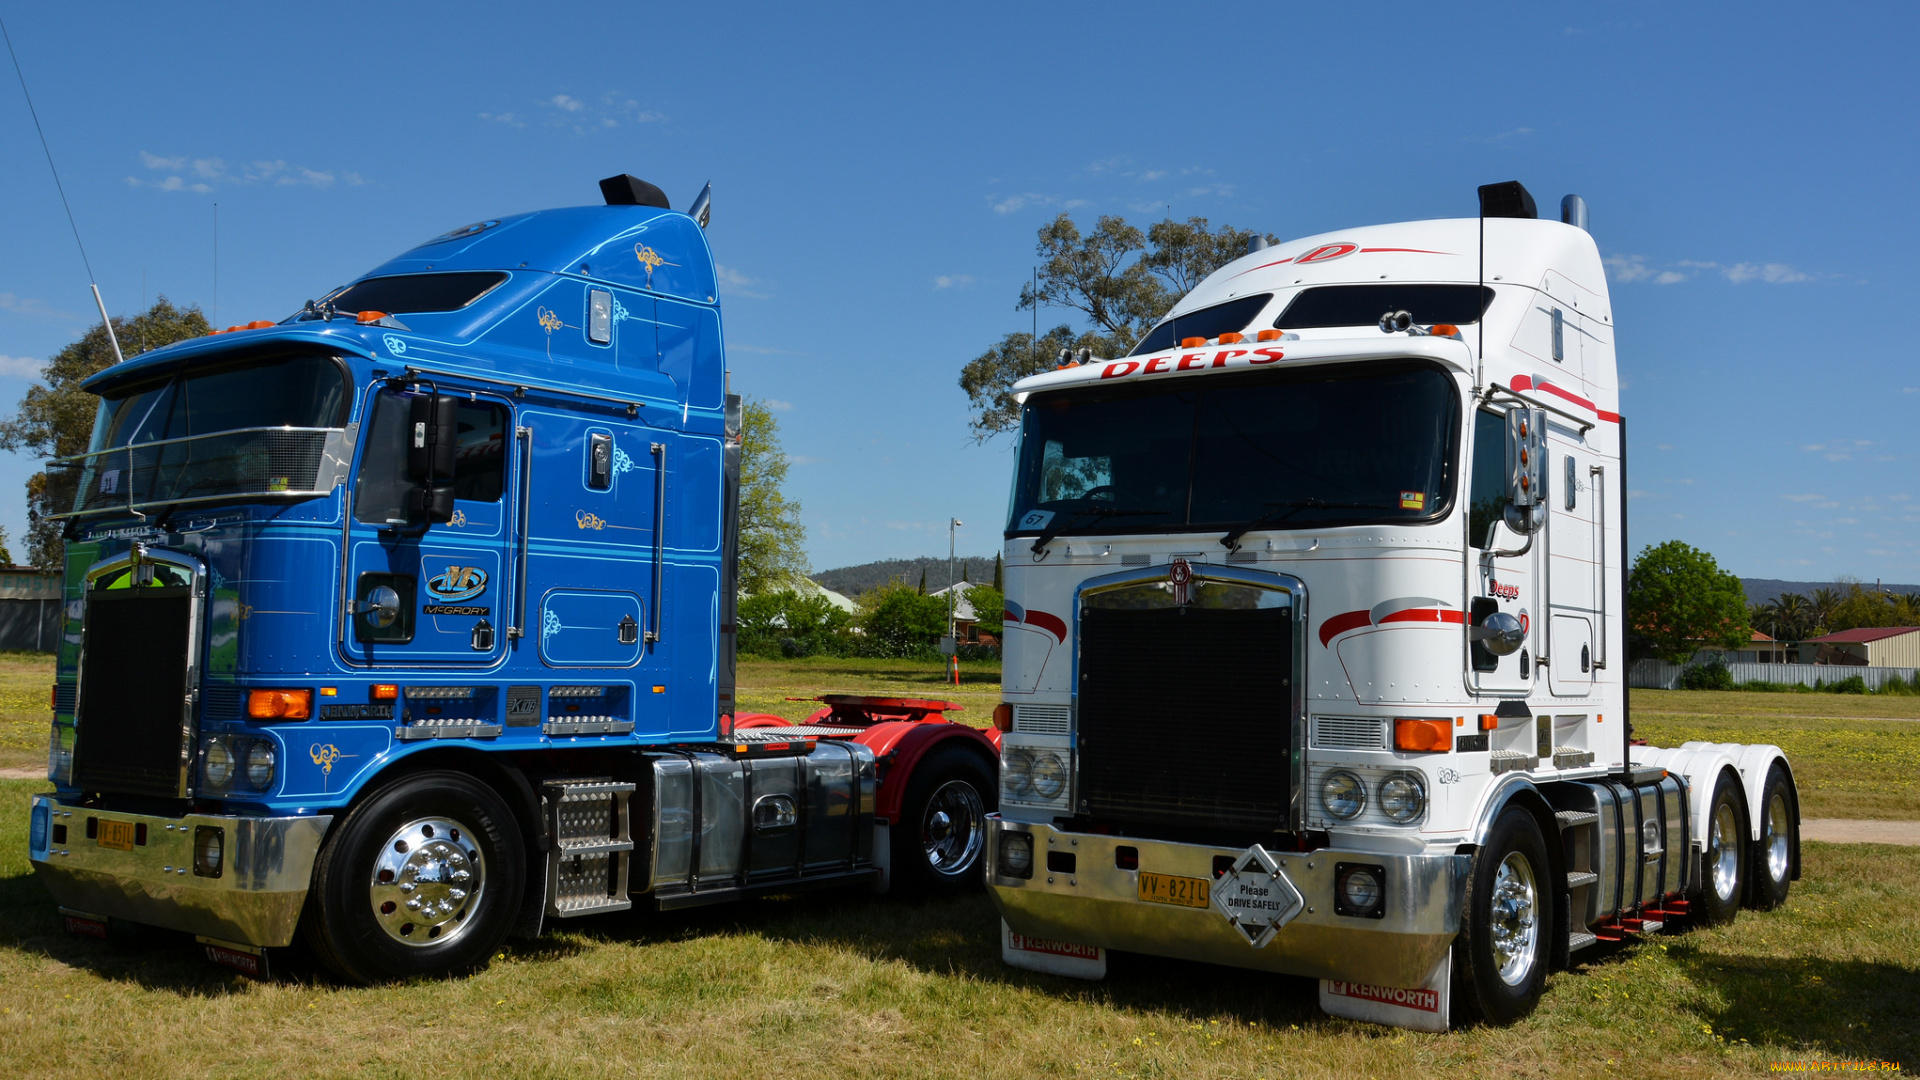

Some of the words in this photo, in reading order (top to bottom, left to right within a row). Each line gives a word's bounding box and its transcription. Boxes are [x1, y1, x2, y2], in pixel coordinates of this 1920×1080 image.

[1100, 346, 1284, 380] DEEPS
[1026, 513, 1044, 526] 67
[0, 575, 63, 592] EMST
[1489, 579, 1519, 601] Deeps
[320, 704, 394, 718] KENWORTH
[1240, 884, 1269, 897] Please
[1228, 897, 1251, 909] DRIVE
[1252, 899, 1281, 911] SAFELY
[1026, 936, 1096, 957] KENWORTH
[1350, 982, 1436, 1009] KENWORTH
